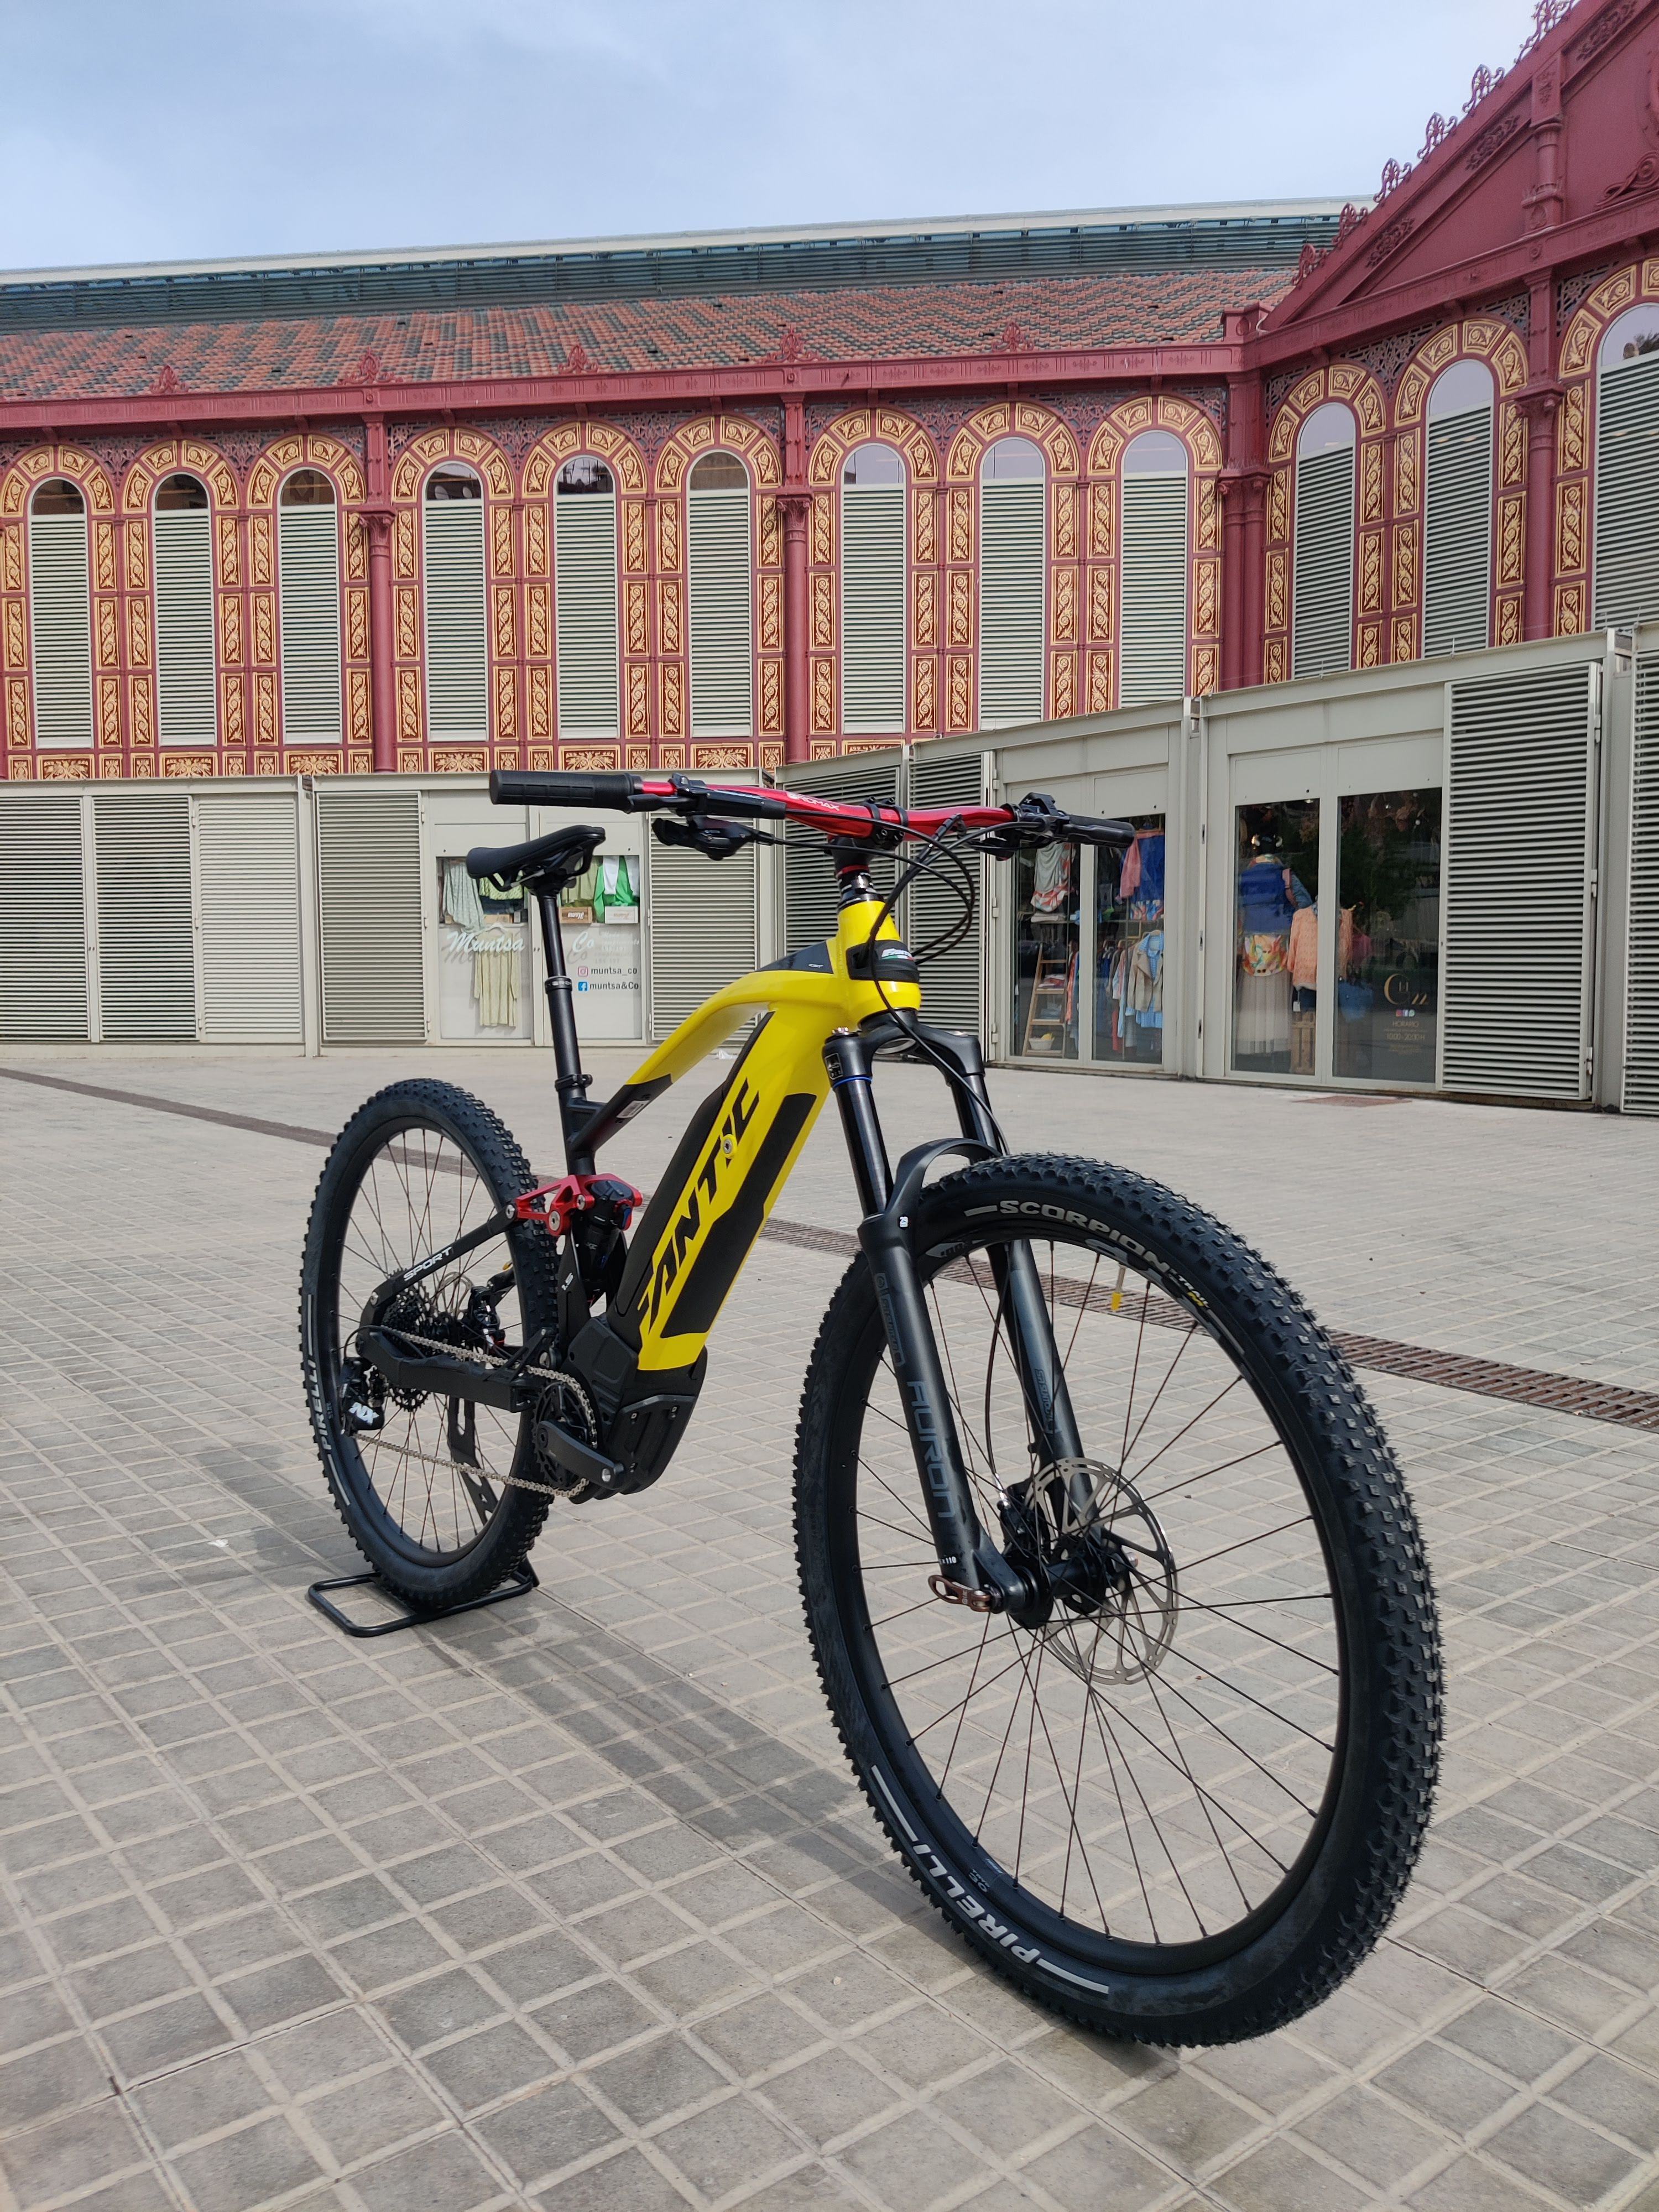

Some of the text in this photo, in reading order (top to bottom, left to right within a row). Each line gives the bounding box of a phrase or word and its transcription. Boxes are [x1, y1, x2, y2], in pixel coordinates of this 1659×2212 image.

[447, 931, 594, 953] Muntsa Co
[591, 966, 638, 976] muntsa_co
[589, 982, 639, 990] muntsa&Co
[999, 1199, 1171, 1273] SCORPION
[403, 1246, 452, 1281] SPORT
[307, 1359, 332, 1450] PIRELLI
[349, 1402, 380, 1426] NX
[912, 1843, 1041, 1964] PIRELLI
